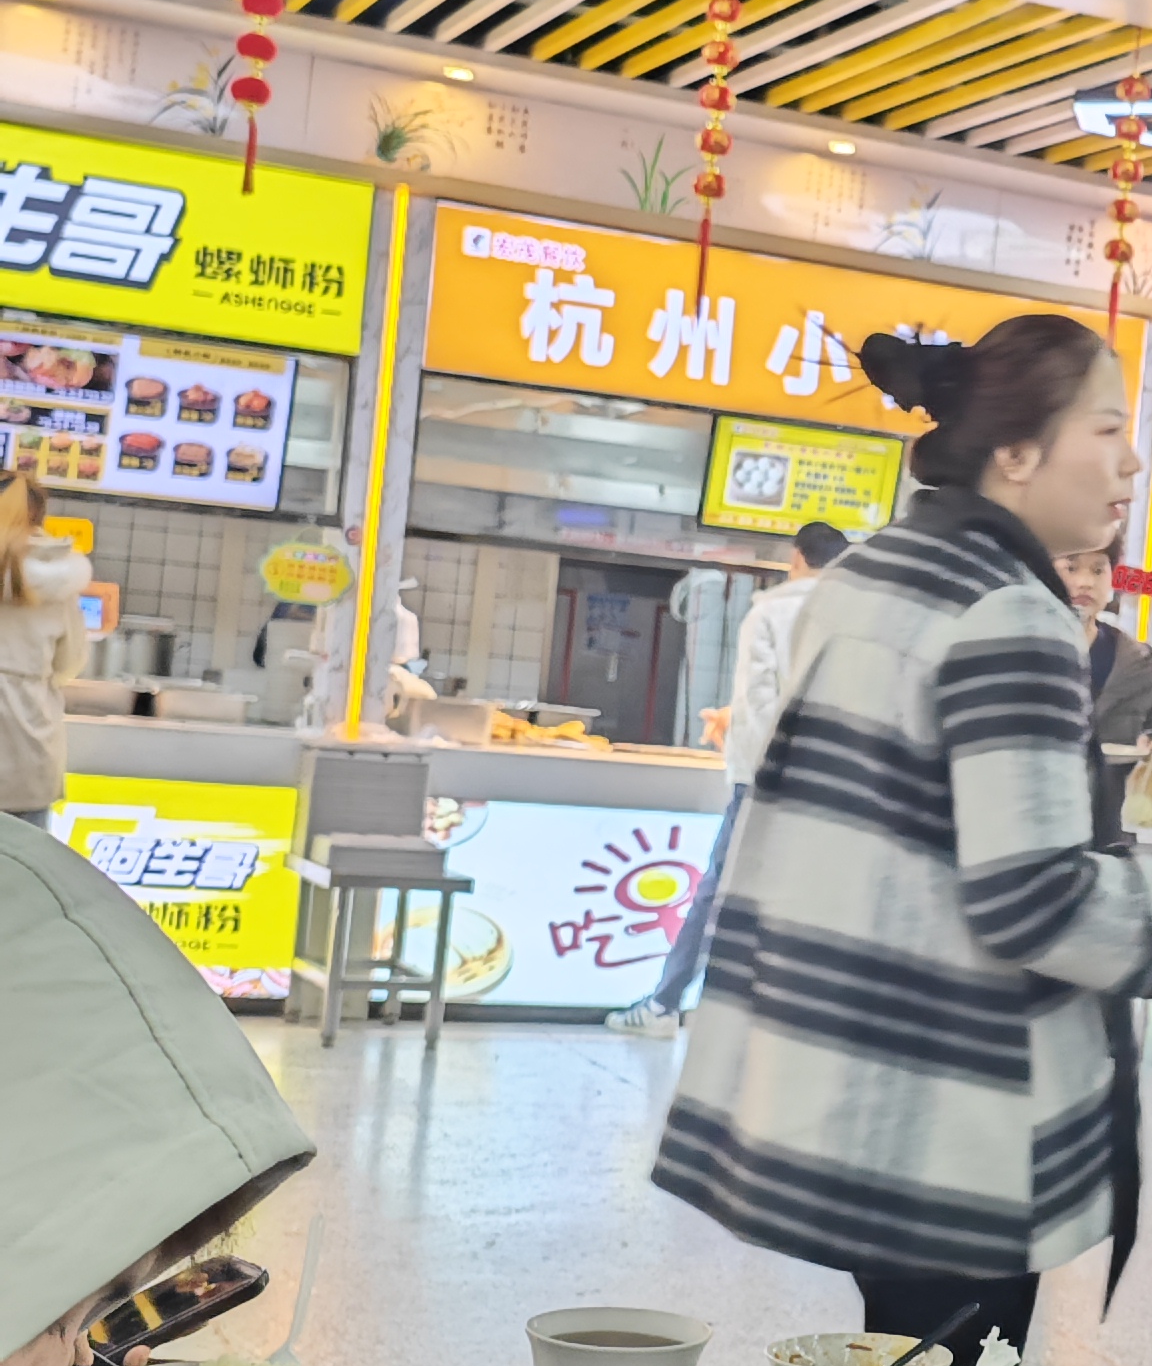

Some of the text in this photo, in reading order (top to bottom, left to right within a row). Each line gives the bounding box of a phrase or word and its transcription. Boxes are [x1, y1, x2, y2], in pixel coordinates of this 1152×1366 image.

[194, 246, 345, 299] 螺蛳粉
[520, 269, 948, 411] 杭州小
